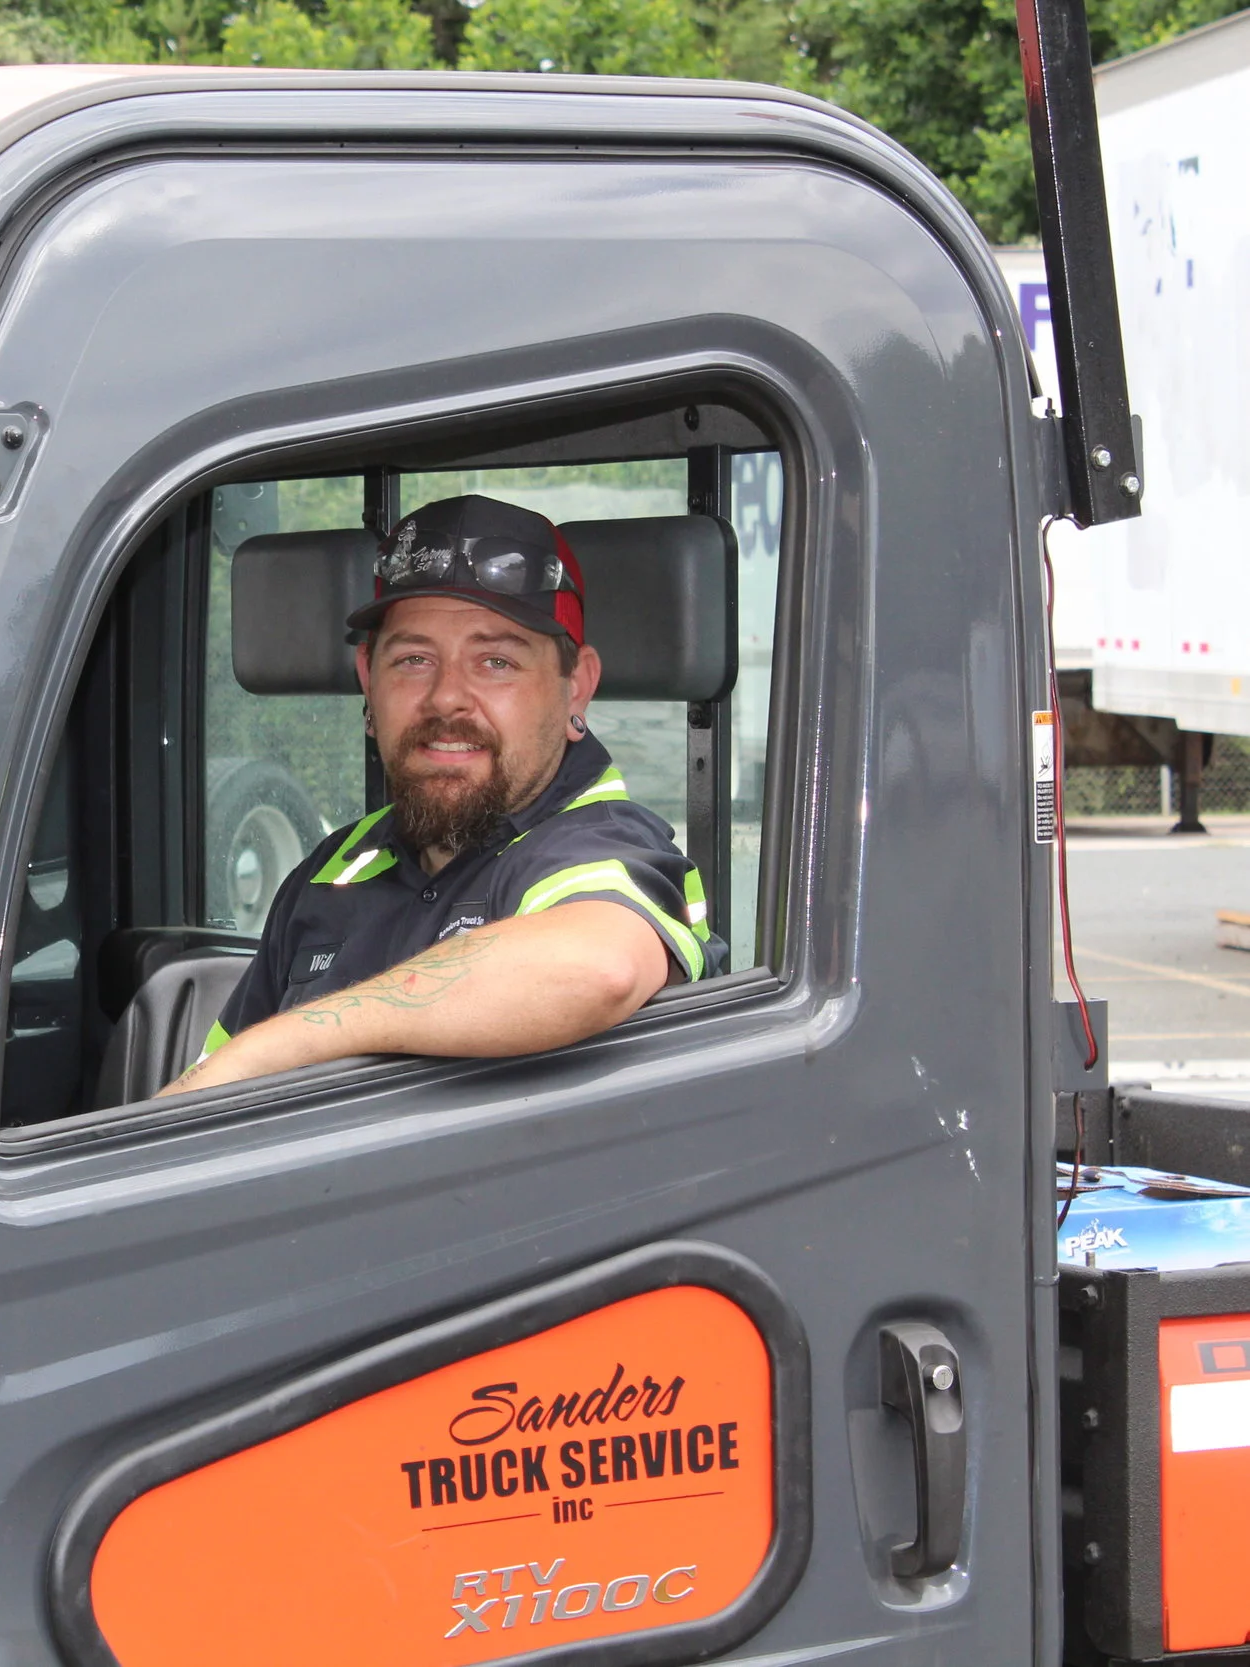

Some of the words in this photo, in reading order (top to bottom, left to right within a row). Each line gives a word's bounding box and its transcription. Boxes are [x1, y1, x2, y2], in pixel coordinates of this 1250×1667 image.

[310, 952, 335, 973] Will
[1065, 1228, 1128, 1257] PEAK
[449, 1362, 685, 1447] Sanders
[400, 1445, 550, 1509] TRUCK
[559, 1422, 740, 1490] SERVICE
[552, 1496, 593, 1524] inc
[452, 1558, 566, 1599] RTV
[444, 1565, 698, 1638] X1100C
